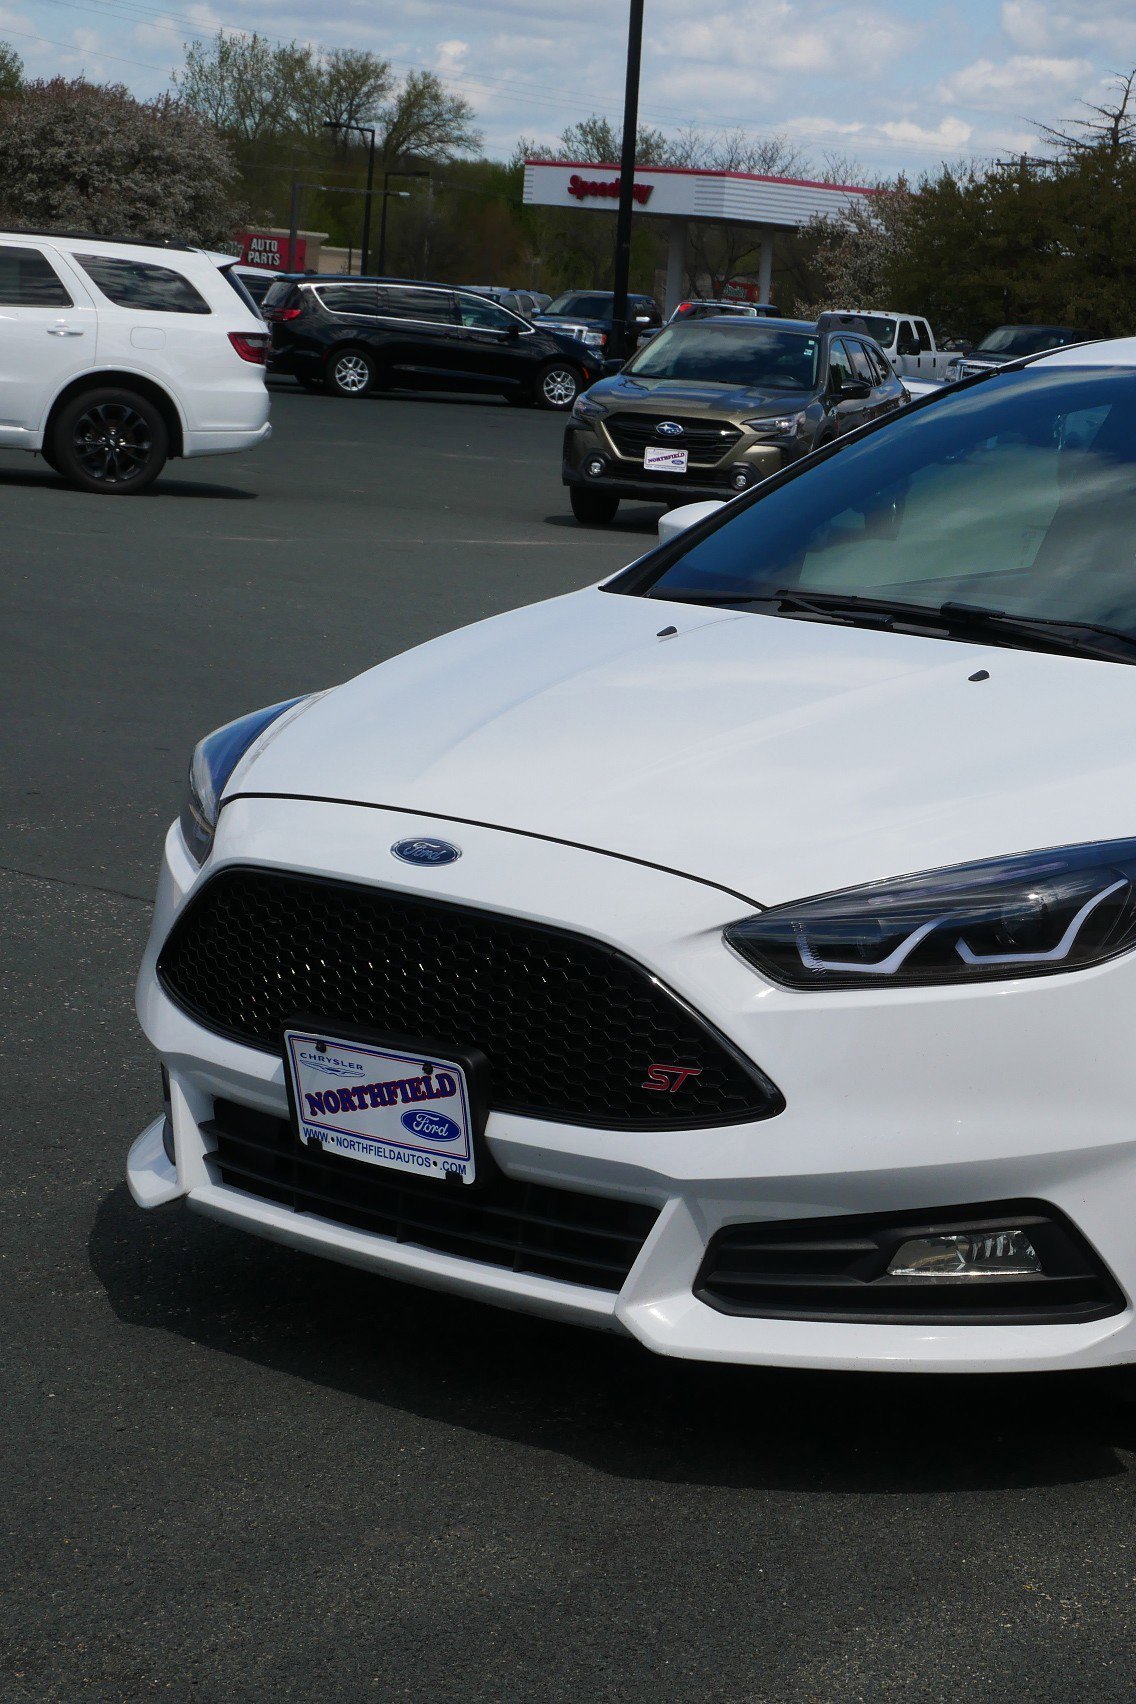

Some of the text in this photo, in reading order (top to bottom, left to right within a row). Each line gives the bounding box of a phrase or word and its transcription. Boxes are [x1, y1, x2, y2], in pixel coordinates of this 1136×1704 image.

[567, 174, 654, 204] Speeday
[251, 238, 278, 252] AUTO
[247, 251, 280, 266] PARTS
[647, 452, 685, 463] NORTHFIELD
[403, 841, 447, 861] Ford
[300, 1052, 364, 1071] CHRYSLER
[641, 1063, 703, 1092] ST
[305, 1072, 457, 1117] NORTHFIELD
[412, 1114, 449, 1137] Ford
